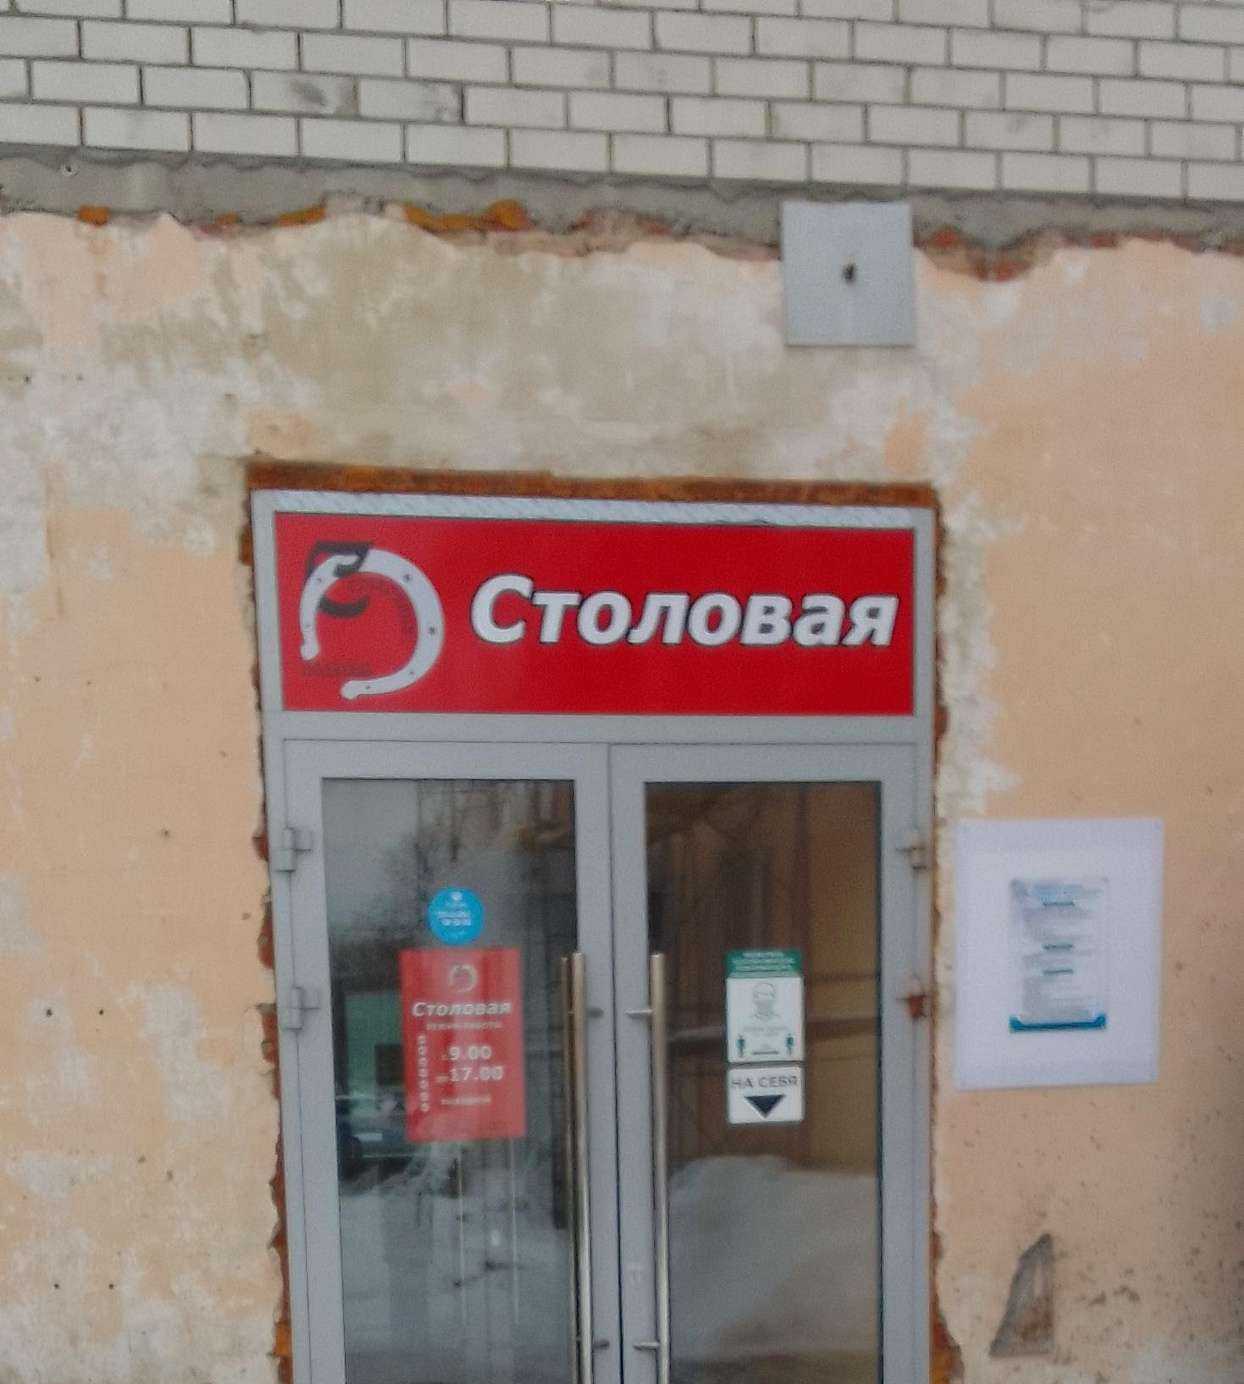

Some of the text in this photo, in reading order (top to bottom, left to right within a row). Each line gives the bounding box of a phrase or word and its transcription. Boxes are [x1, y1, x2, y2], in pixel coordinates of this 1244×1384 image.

[470, 573, 898, 646] Столовая
[411, 1001, 512, 1017] Столовая
[449, 1066, 504, 1082] 17.00
[731, 1075, 798, 1089] НА СЕБЯ
